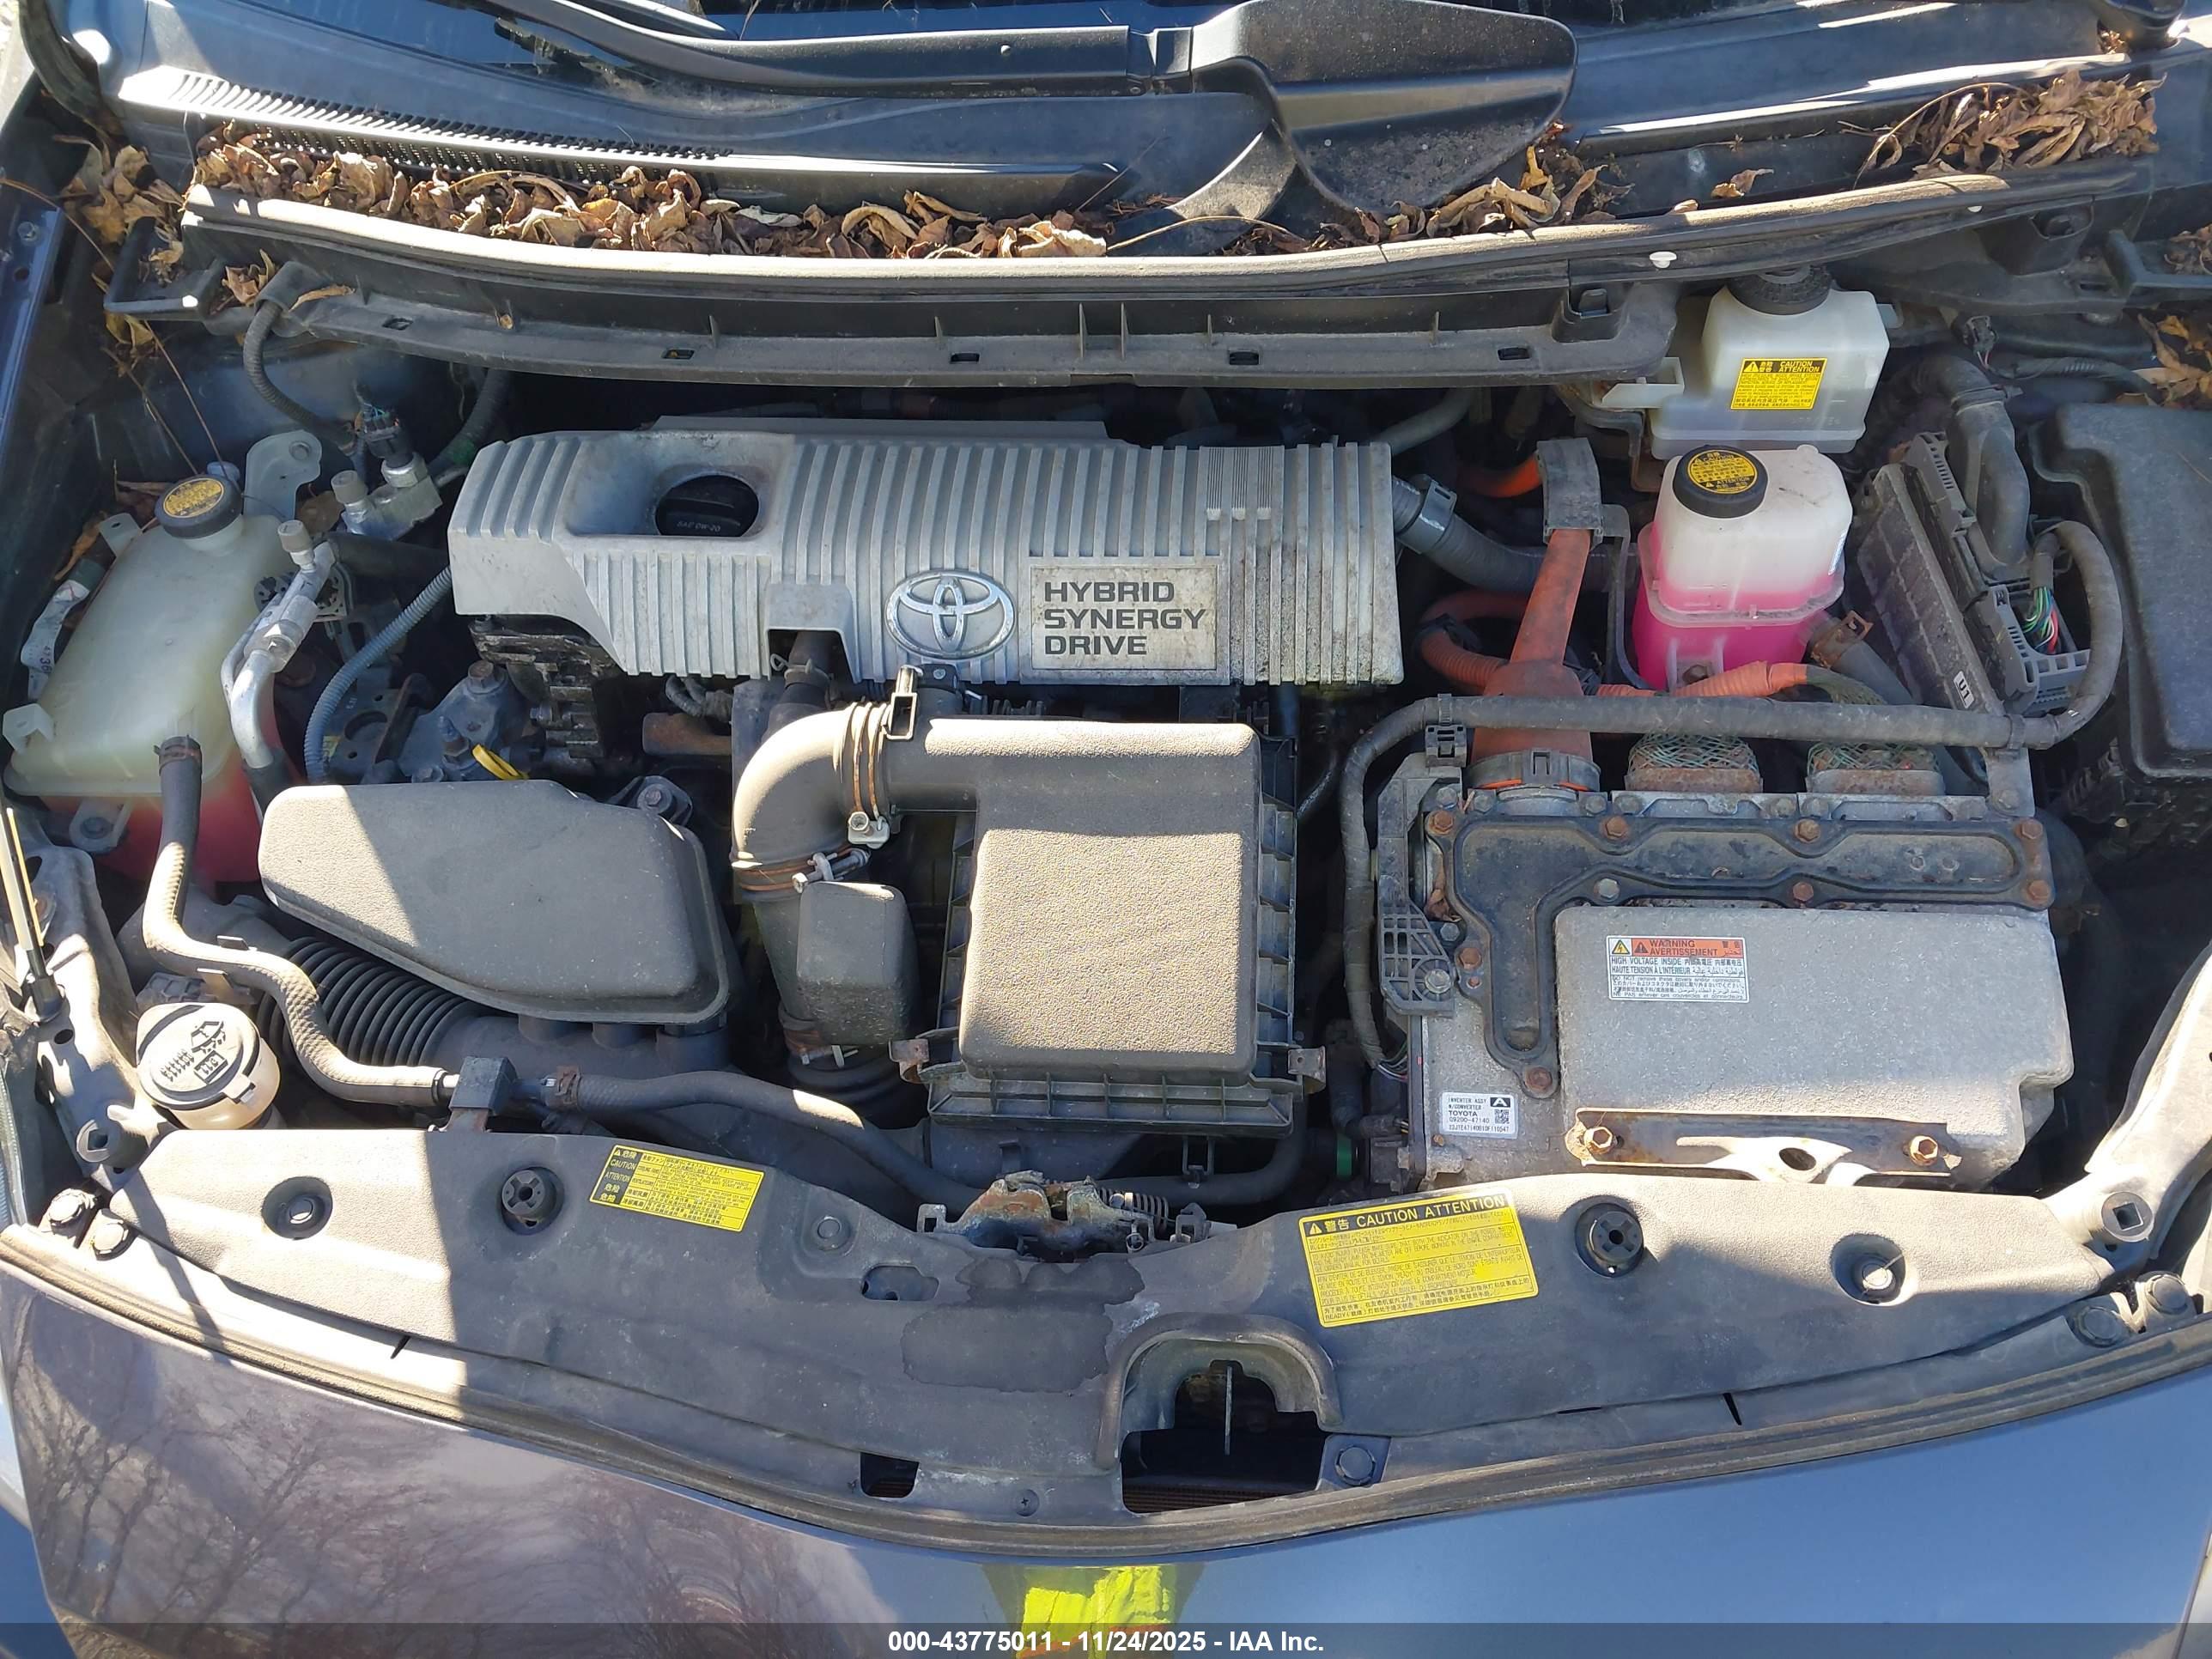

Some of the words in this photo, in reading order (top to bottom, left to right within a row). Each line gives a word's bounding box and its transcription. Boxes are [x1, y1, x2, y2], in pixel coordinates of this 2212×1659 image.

[1044, 581, 1175, 603] HYBRID
[1043, 609, 1206, 629] SYNERGY
[1044, 635, 1148, 655] DRIVE
[1960, 678, 1969, 699] U1
[1650, 947, 1717, 956] AVERTISSEMENT
[609, 1158, 636, 1170] CAUTION
[604, 1170, 631, 1182] ATTENTION
[1323, 1218, 1350, 1233] 警告
[1356, 1207, 1419, 1229] CAUTION
[1425, 1195, 1506, 1218] ATTENTION
